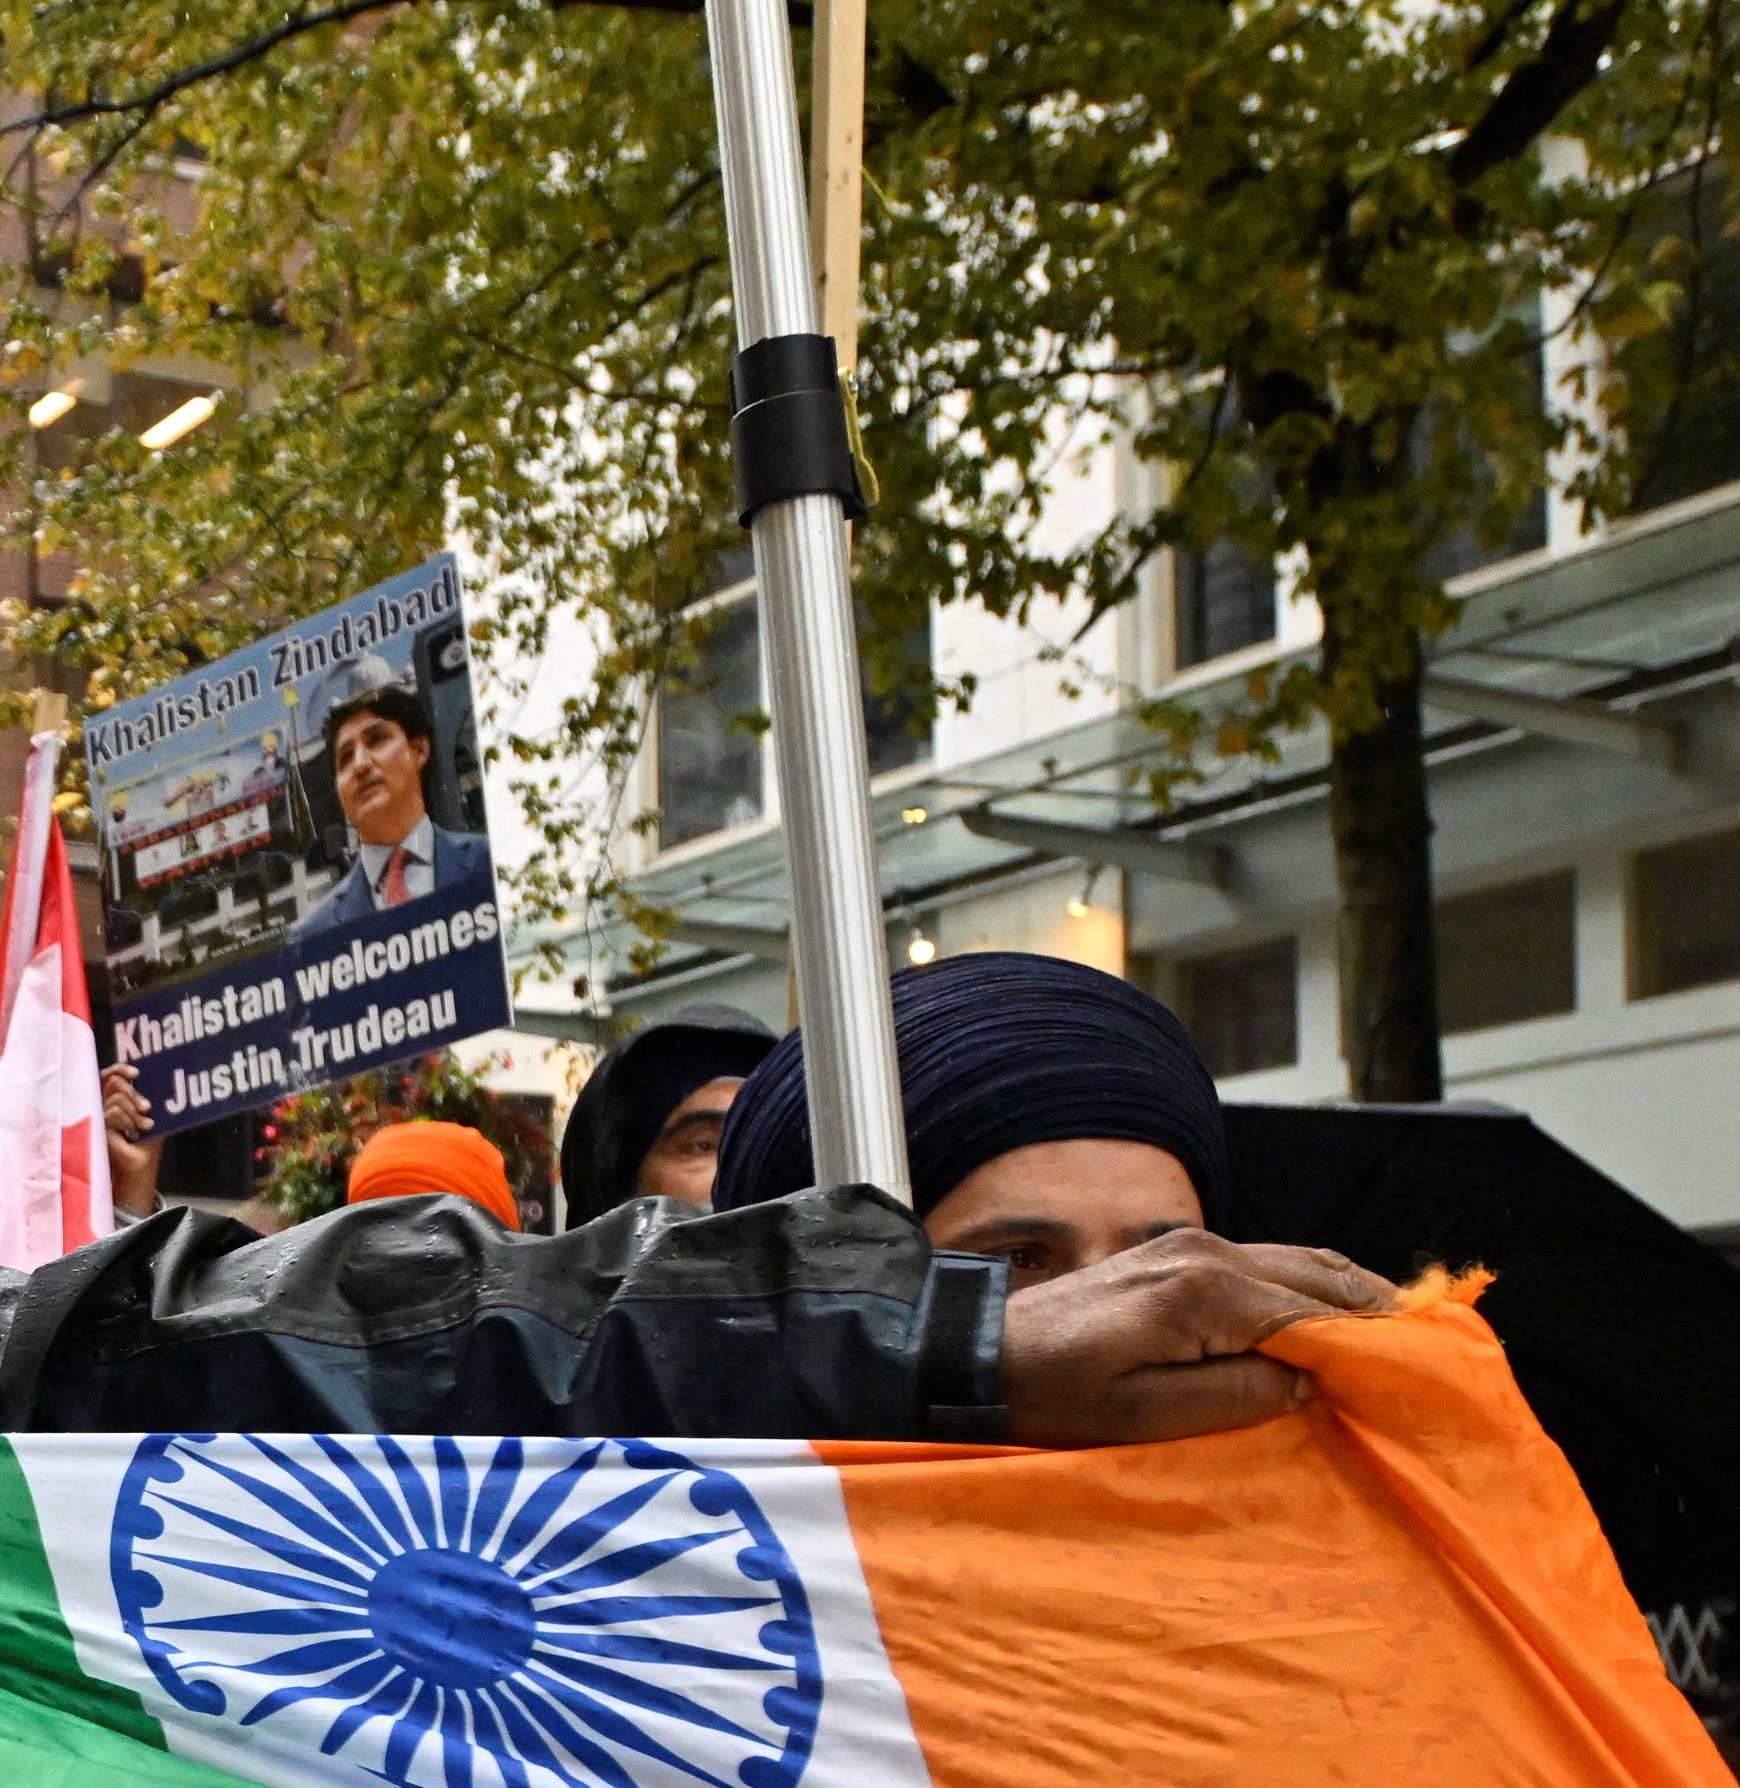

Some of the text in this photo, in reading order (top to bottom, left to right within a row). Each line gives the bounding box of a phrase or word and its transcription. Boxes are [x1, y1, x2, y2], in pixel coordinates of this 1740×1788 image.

[88, 666, 260, 766] Khalistan
[114, 901, 499, 1064] Khalistan welcomes
[165, 988, 456, 1115] Justin Trudeau
